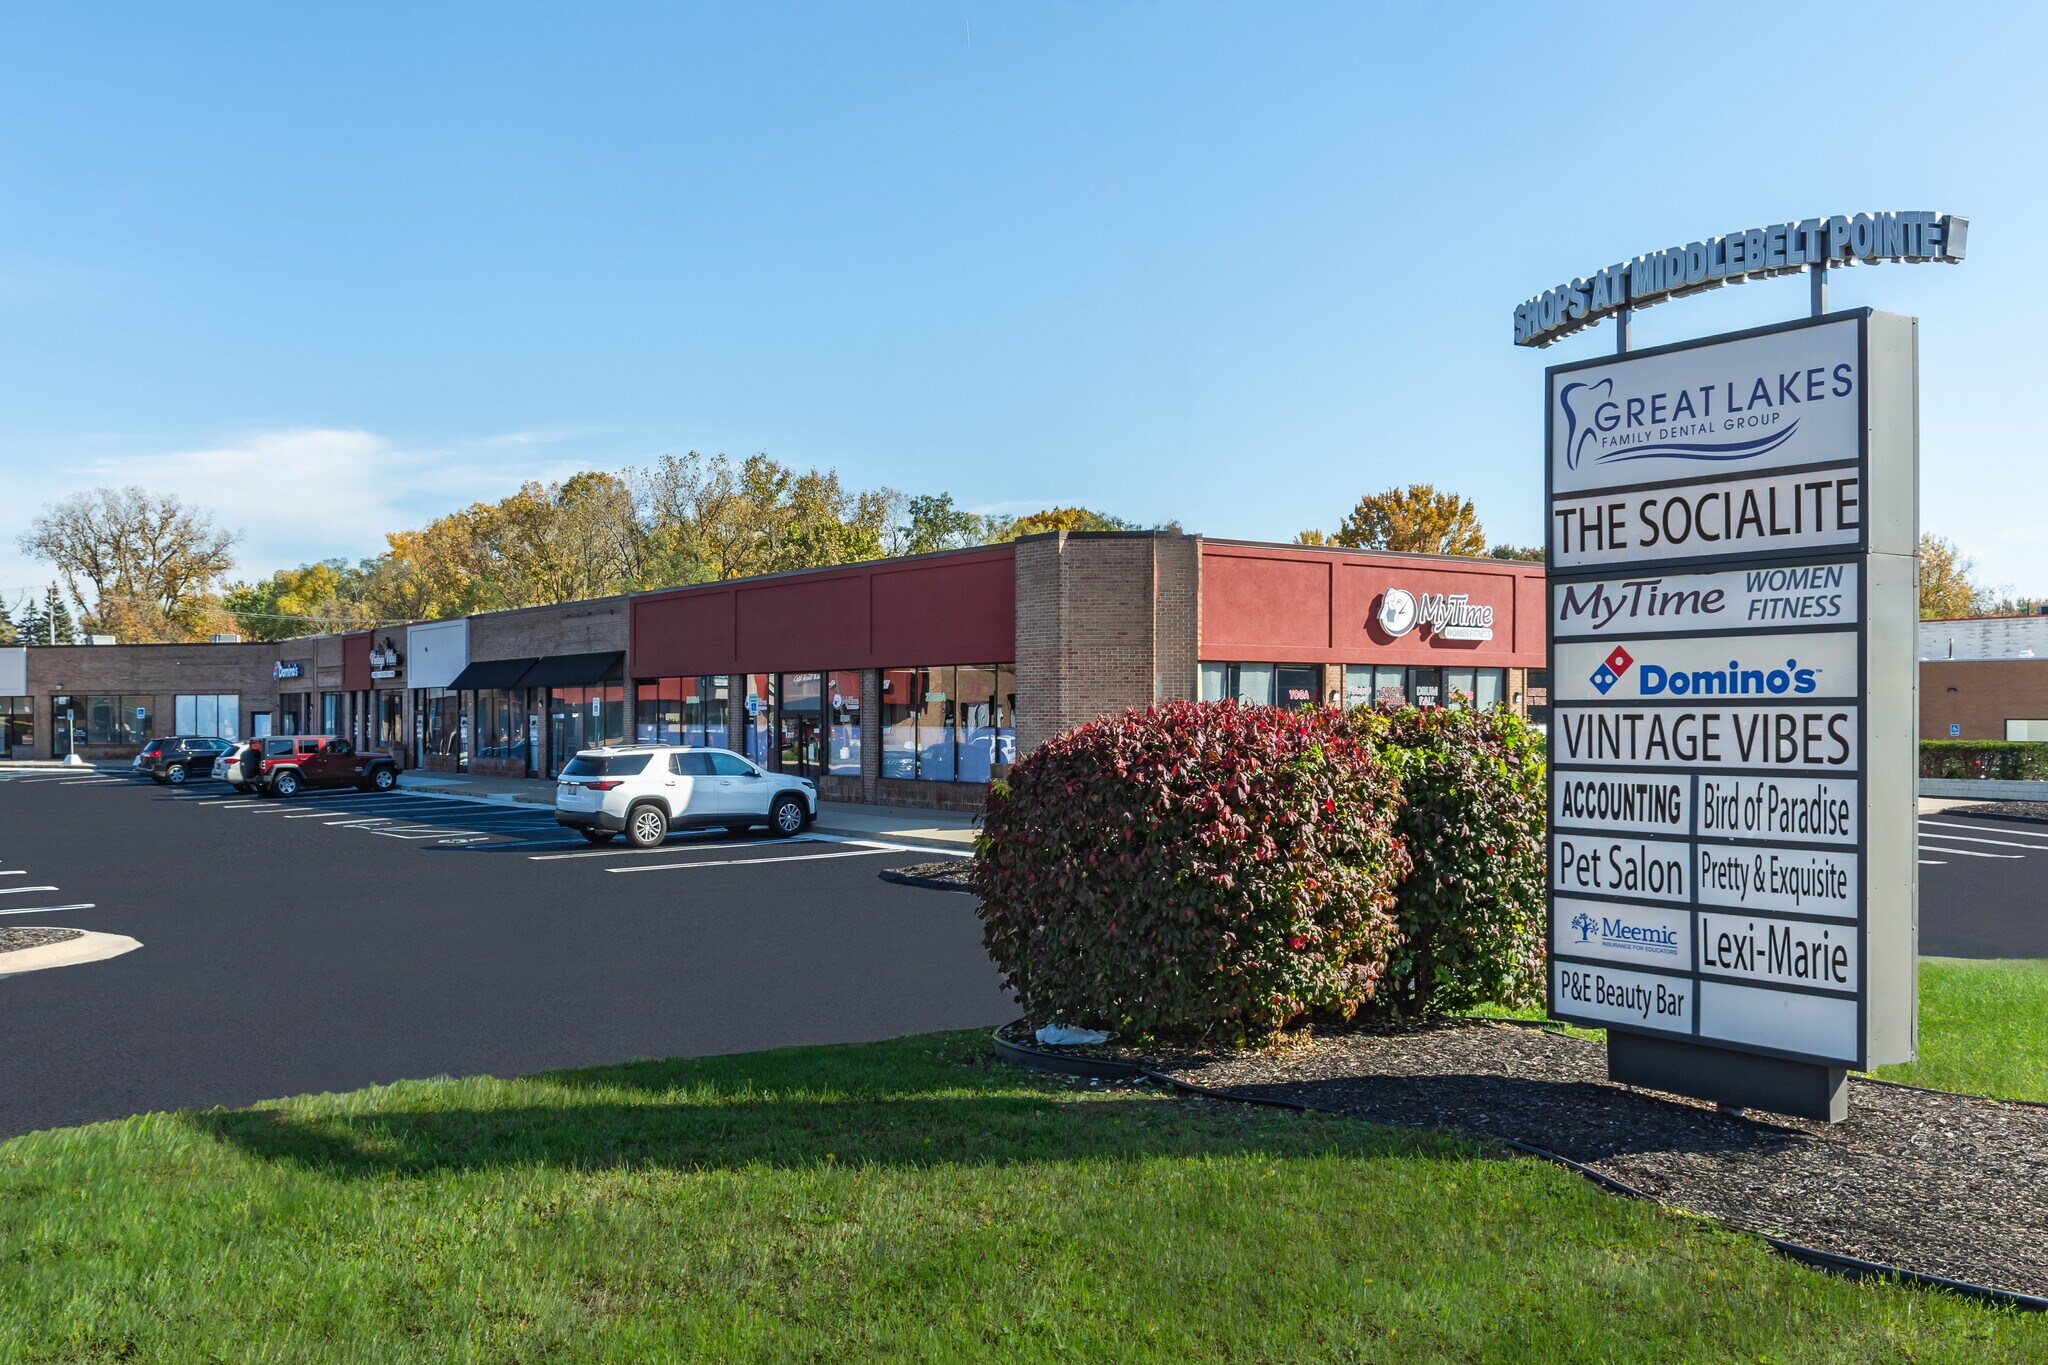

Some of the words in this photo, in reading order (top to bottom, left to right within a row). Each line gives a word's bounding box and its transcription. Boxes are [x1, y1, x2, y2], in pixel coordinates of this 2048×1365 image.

[1514, 277, 1591, 344] SHOPS
[1591, 262, 1629, 312] AT
[1631, 219, 1824, 298] MIDDLEBELT
[1830, 211, 1941, 259] POINTE
[1594, 385, 1715, 432] GREAT
[1728, 363, 1852, 413] LAKES
[1602, 431, 1652, 447] FAMILY
[1659, 421, 1715, 440] DENTAL
[1724, 412, 1780, 431] GROUP
[1555, 503, 1627, 553] THE
[1639, 478, 1859, 547] SOCIALITE
[1746, 566, 1843, 593] WOMEN
[1418, 593, 1493, 634] MyTime
[1560, 579, 1725, 630] MyTime
[1747, 594, 1842, 620] FITNESS
[1446, 628, 1469, 637] WOMEN
[1470, 629, 1492, 639] FITNESS
[1289, 689, 1309, 700] YOGA
[1416, 686, 1438, 696] DRUM
[1640, 659, 1816, 695] Domino's
[1563, 713, 1721, 762] VINTAGE
[1732, 713, 1850, 764] VIBES
[1562, 781, 1681, 824] ACCOUNTING
[1704, 782, 1739, 830] Bird
[1745, 782, 1764, 832] of
[1768, 784, 1849, 836] Paradise
[1561, 841, 1601, 887] Pet
[1609, 844, 1683, 895] Salon
[1702, 851, 1749, 901] Pretty
[1754, 854, 1766, 893] &
[1770, 855, 1847, 906] Exquisite
[1602, 917, 1678, 945] Meemic
[1602, 941, 1632, 950] INSURANCE
[1645, 946, 1678, 956] EDUCATORS
[1703, 918, 1848, 983] Lexi-Marie
[1561, 971, 1592, 1003] P&E
[1596, 975, 1652, 1020] Beauty
[1656, 984, 1684, 1016] Bar
